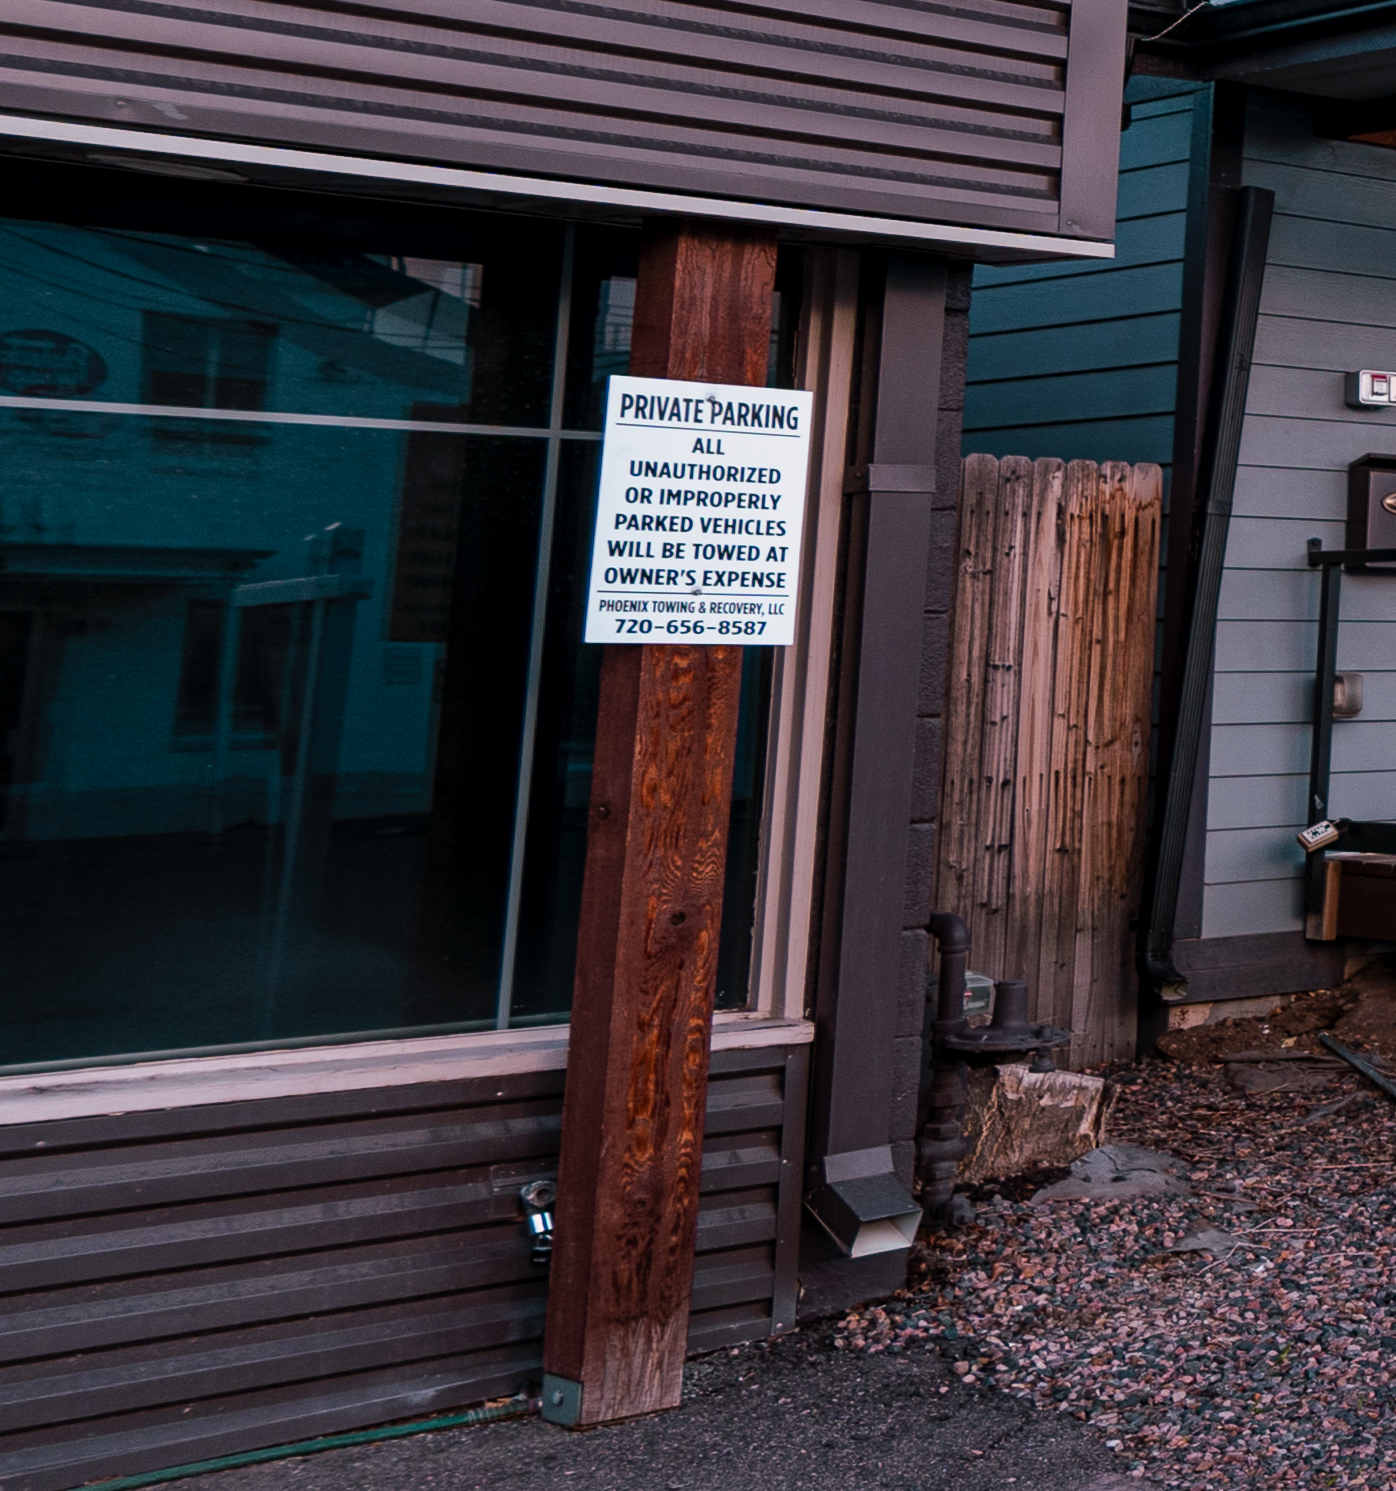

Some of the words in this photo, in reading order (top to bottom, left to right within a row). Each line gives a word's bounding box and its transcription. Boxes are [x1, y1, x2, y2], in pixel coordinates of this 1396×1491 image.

[620, 393, 705, 424] PRIVATE
[710, 400, 800, 431] PARKING
[691, 437, 725, 456] ALL
[629, 460, 782, 485] UNAUTHORIZED
[625, 486, 653, 505] OR
[659, 488, 782, 511] IMPROPERLY
[614, 513, 693, 533] PARKED
[700, 517, 787, 537] VEHICLES
[607, 540, 655, 559] WILL
[661, 542, 686, 560] BE
[692, 543, 761, 562] TOWED
[765, 546, 789, 563] AT
[604, 567, 697, 587] OWNER'S
[702, 570, 787, 589] EXPENSE
[599, 599, 649, 613] PHOENIX
[652, 600, 696, 614] TOWING
[698, 602, 706, 615] &
[709, 602, 765, 617] RECOVERY,
[768, 603, 785, 616] LLC
[615, 618, 768, 636] 720-656-8587
